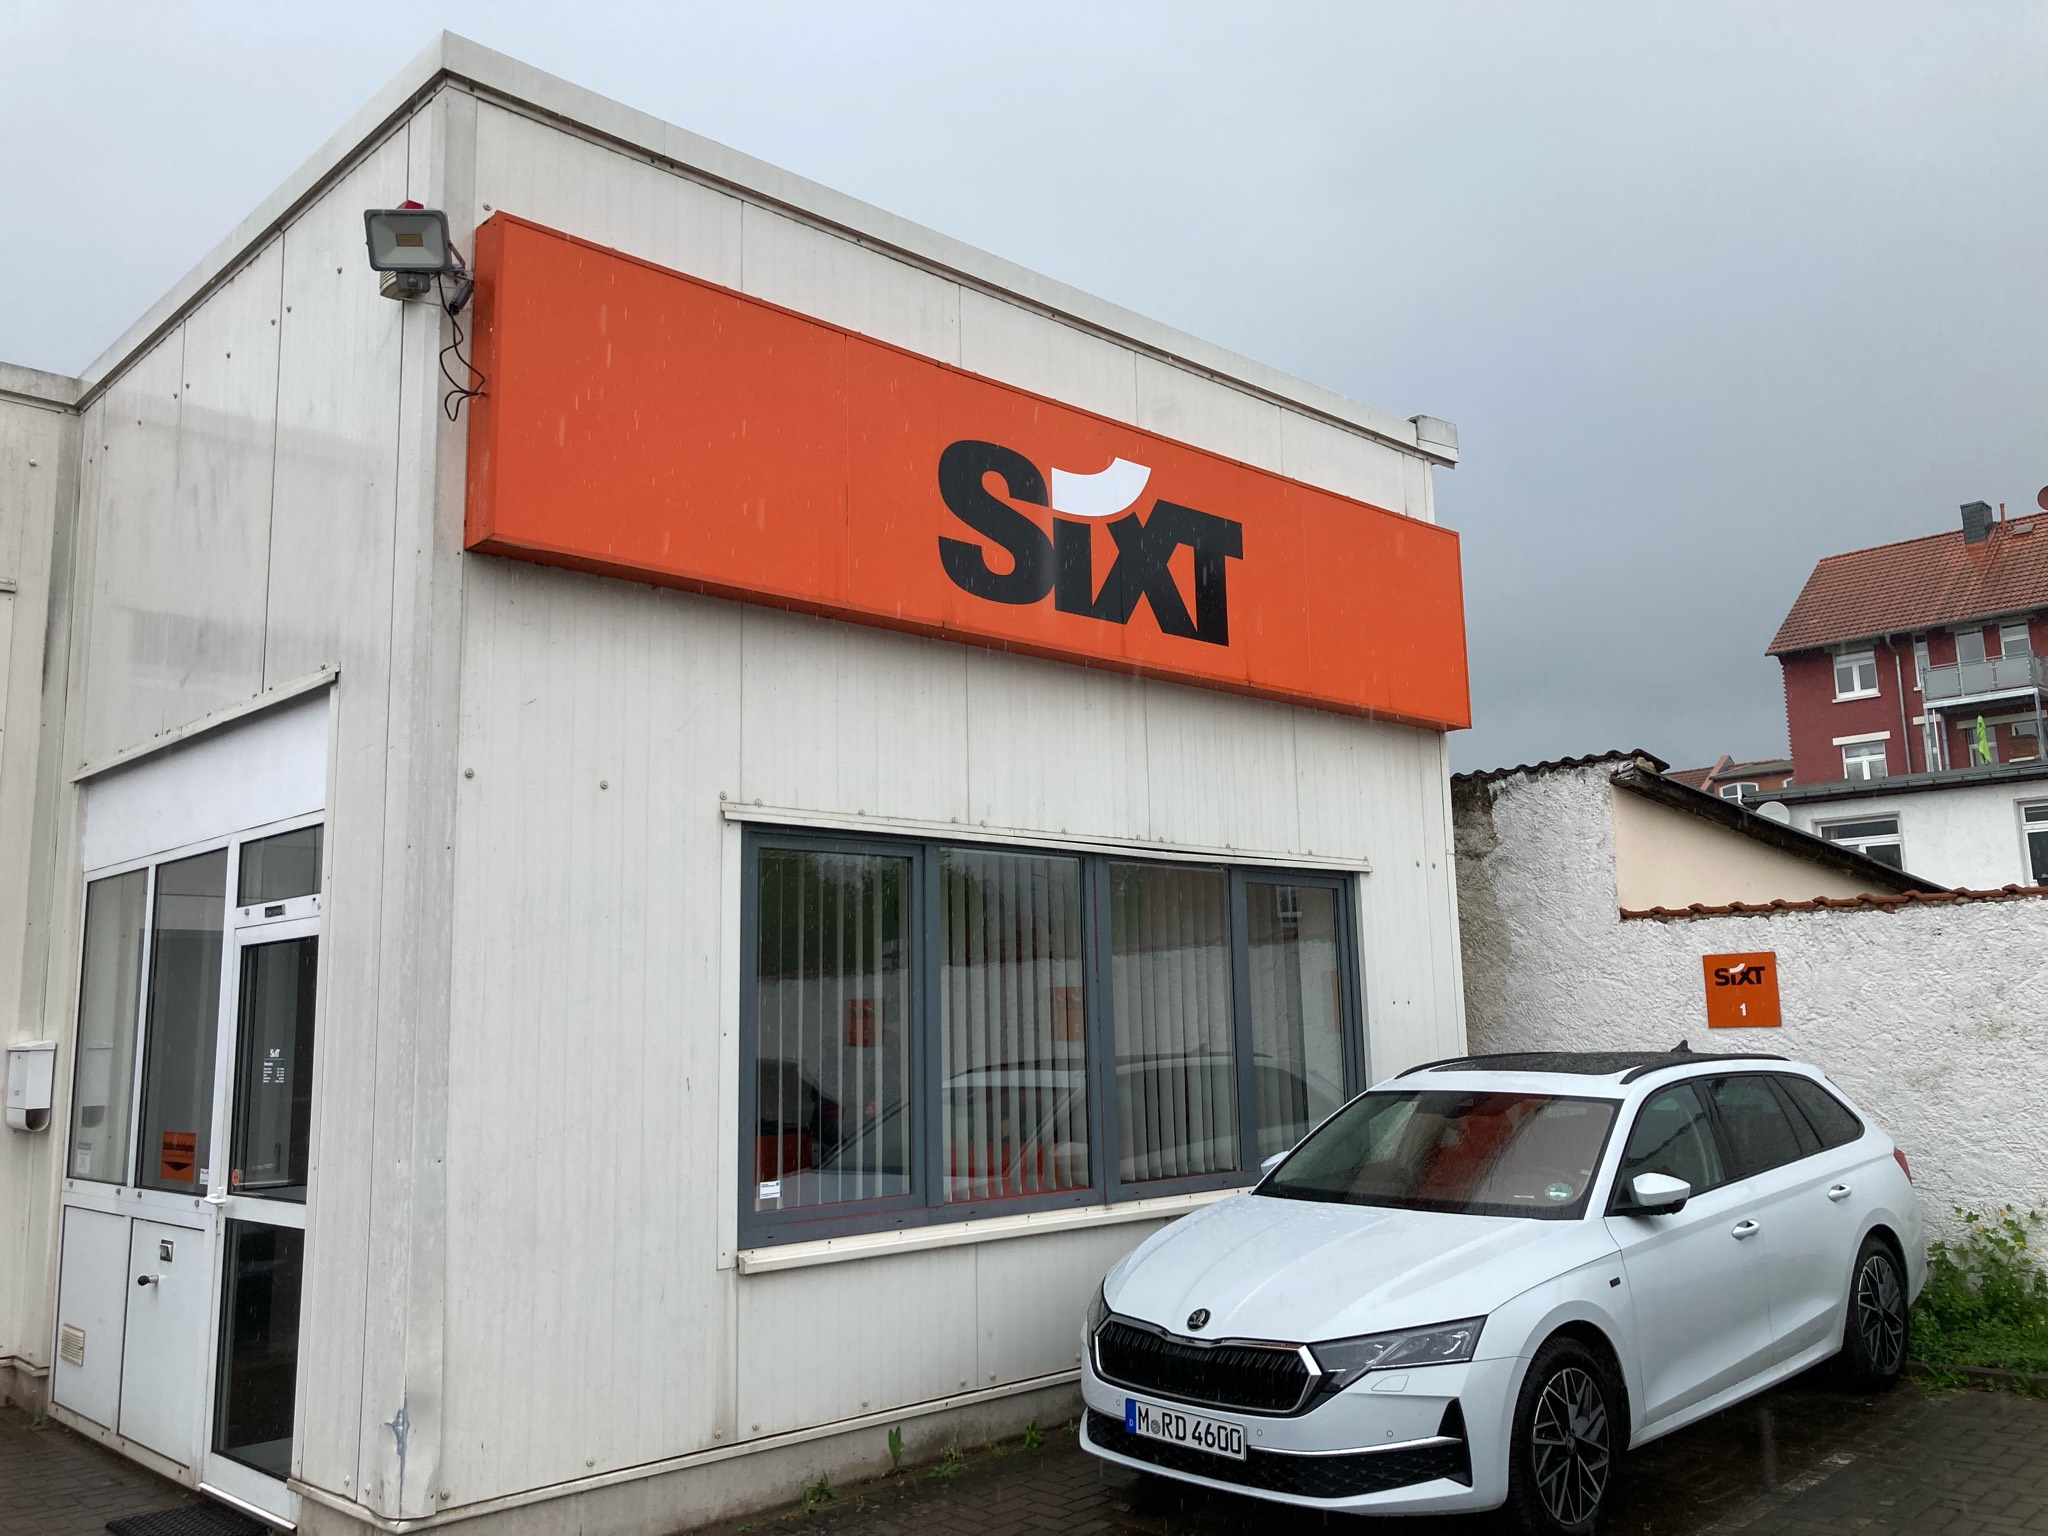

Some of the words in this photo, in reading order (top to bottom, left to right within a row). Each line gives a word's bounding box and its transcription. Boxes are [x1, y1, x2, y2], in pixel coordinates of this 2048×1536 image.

[1739, 1002, 1747, 1016] 1
[1138, 1406, 1149, 1432] M
[1162, 1412, 1187, 1441] RD
[1192, 1420, 1242, 1455] 4600
